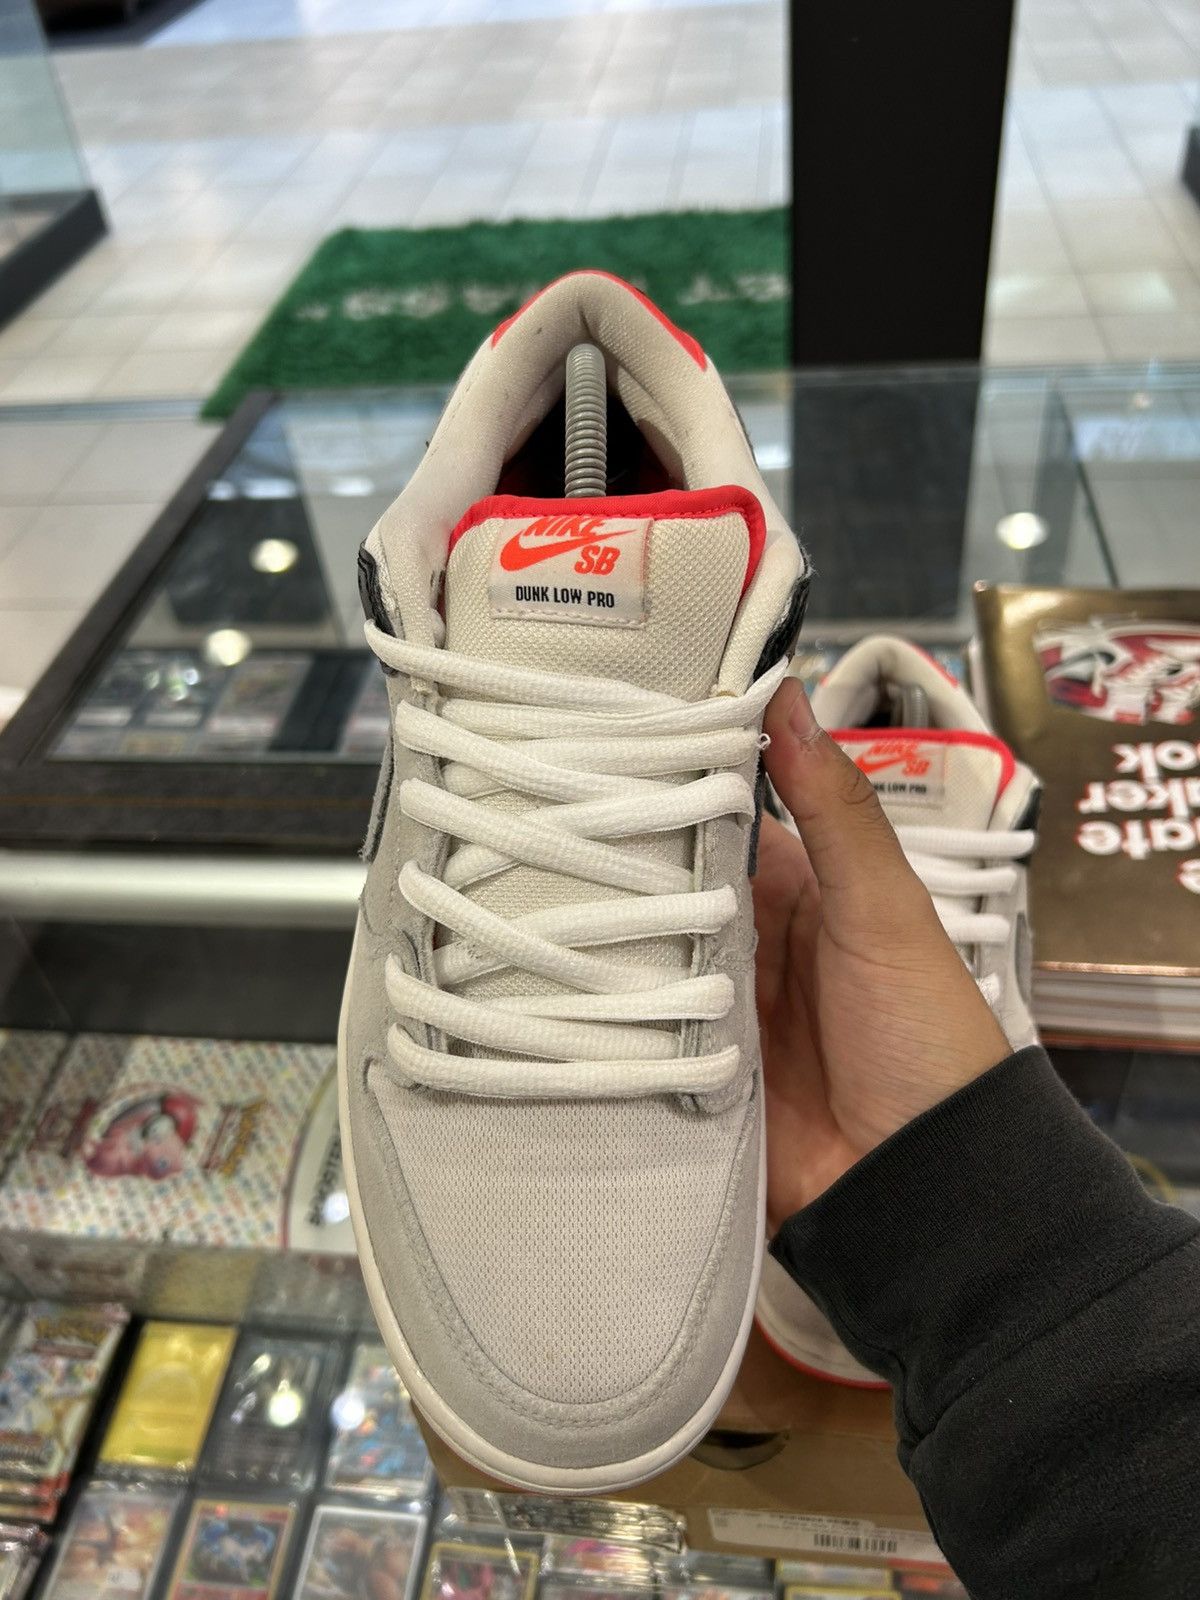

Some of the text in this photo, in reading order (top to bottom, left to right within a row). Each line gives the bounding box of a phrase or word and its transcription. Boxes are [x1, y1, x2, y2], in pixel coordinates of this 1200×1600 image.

[523, 515, 605, 538] NIKE
[574, 545, 620, 575] SB
[515, 585, 615, 608] DUNK LOW PRO
[1112, 739, 1200, 784] ok
[1076, 818, 1200, 860] ate
